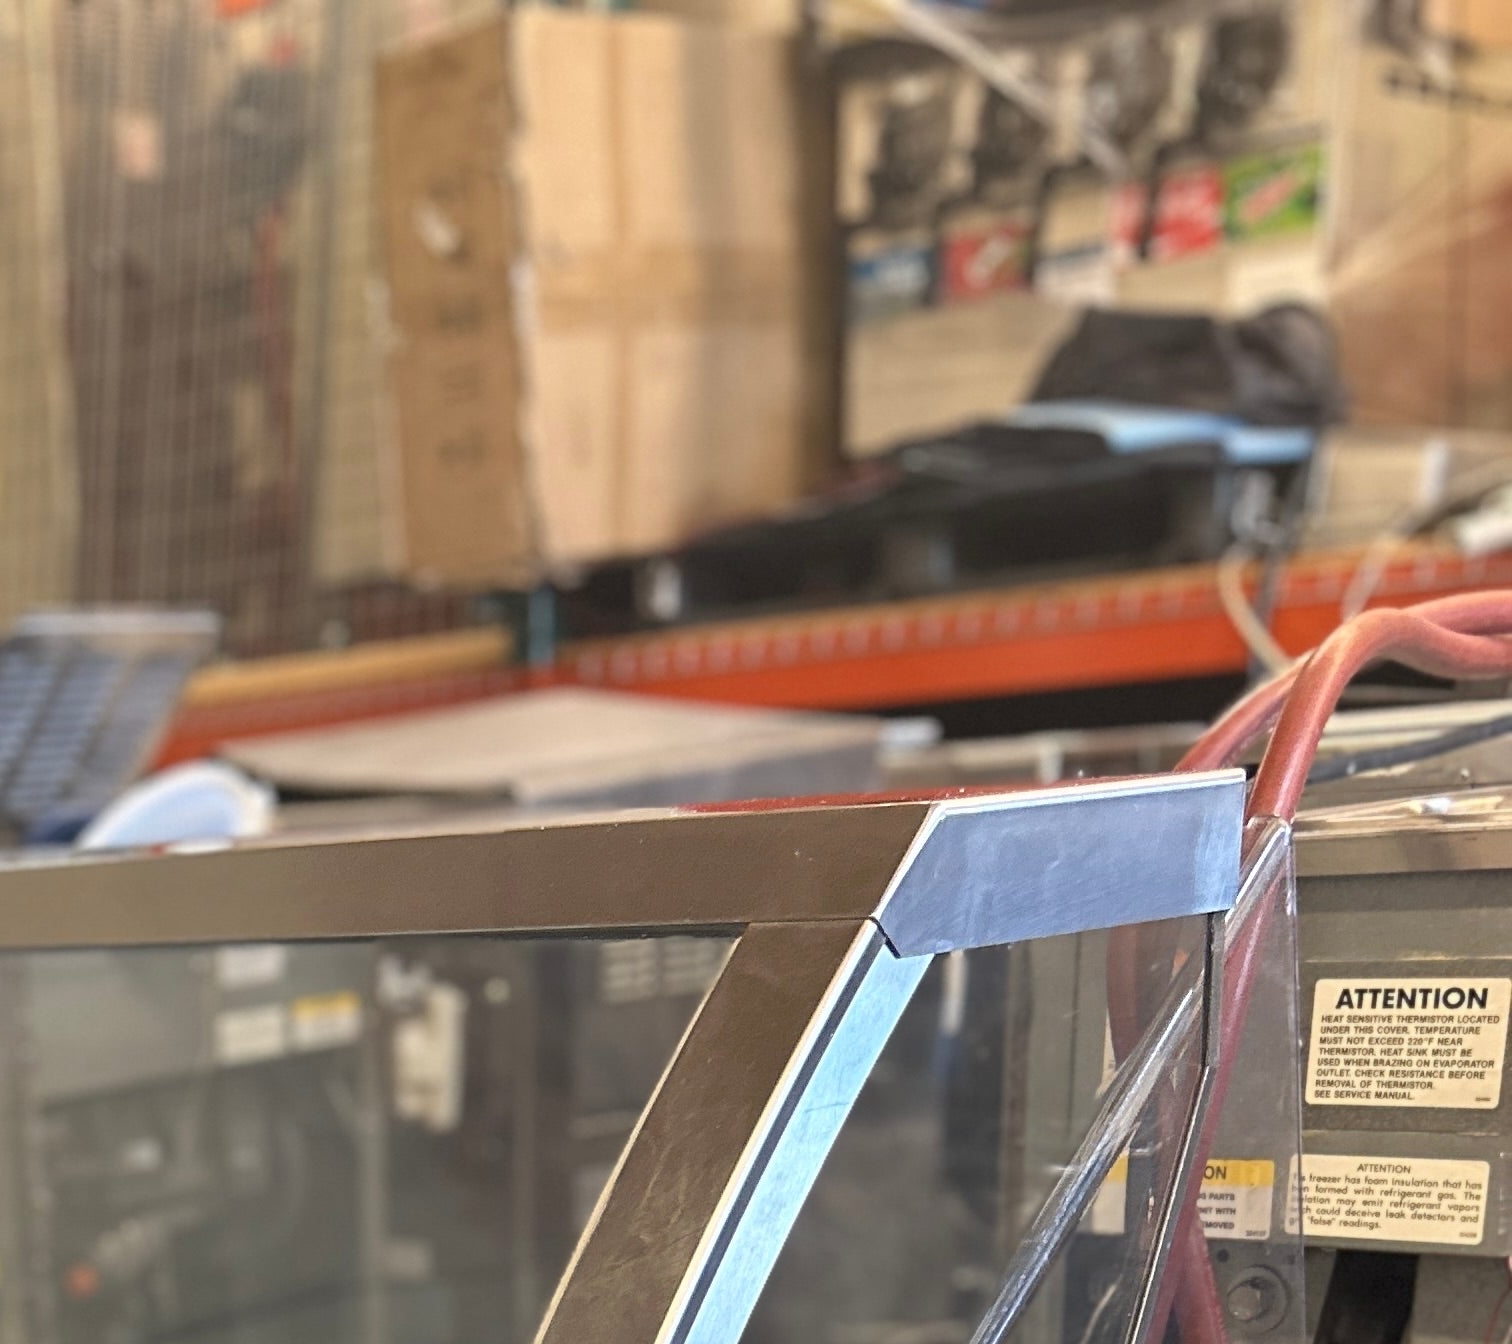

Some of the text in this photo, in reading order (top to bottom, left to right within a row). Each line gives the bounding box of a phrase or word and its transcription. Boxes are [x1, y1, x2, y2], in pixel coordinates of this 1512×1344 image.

[1336, 987, 1488, 1010] ATTENTION
[1322, 1015, 1500, 1024] HEAT SENSITIVE THERMISTOR LOCATED
[1320, 1026, 1480, 1035] UNDER THIS COVER. TEMPERATURE
[1320, 1037, 1344, 1045] MUST
[1346, 1037, 1365, 1045] NOT
[1368, 1037, 1404, 1045] EXCEED
[1438, 1038, 1463, 1046] NEAR
[1319, 1048, 1376, 1056] THERMISTOR.
[1380, 1048, 1403, 1056] HEAT
[1432, 1049, 1457, 1057] MUST
[1460, 1049, 1473, 1057] BE
[1318, 1058, 1340, 1066] USED
[1344, 1058, 1370, 1066] WHEN
[1373, 1059, 1413, 1067] BRAZING
[1433, 1060, 1495, 1068] EVAPORATOR
[1354, 1069, 1385, 1077] CHECK
[1388, 1070, 1445, 1078] RESISTANCE
[1448, 1071, 1486, 1079] BEFORE
[1316, 1080, 1356, 1088] REMOVAL
[1360, 1080, 1373, 1088] OF
[1314, 1090, 1415, 1100] SEE SERVICE MANUAL.
[1357, 1164, 1411, 1174] ATTENTION
[1309, 1173, 1341, 1183] freezer
[1345, 1175, 1360, 1184] has
[1364, 1175, 1388, 1184] foam
[1392, 1178, 1438, 1188] insulation
[1442, 1180, 1462, 1189] that
[1465, 1180, 1482, 1189] has
[1316, 1184, 1348, 1194] formed
[1354, 1187, 1374, 1195] with
[1380, 1188, 1432, 1200] refrigerant
[1464, 1192, 1480, 1200] The
[1336, 1199, 1356, 1208] may
[1390, 1201, 1441, 1210] refrigerant
[1448, 1204, 1480, 1213] vapors
[1316, 1206, 1340, 1216] could
[1345, 1207, 1380, 1218] deceive
[1386, 1210, 1406, 1218] leak
[1411, 1212, 1455, 1222] detectors
[1460, 1214, 1478, 1223] and
[1339, 1219, 1381, 1230] readings.
